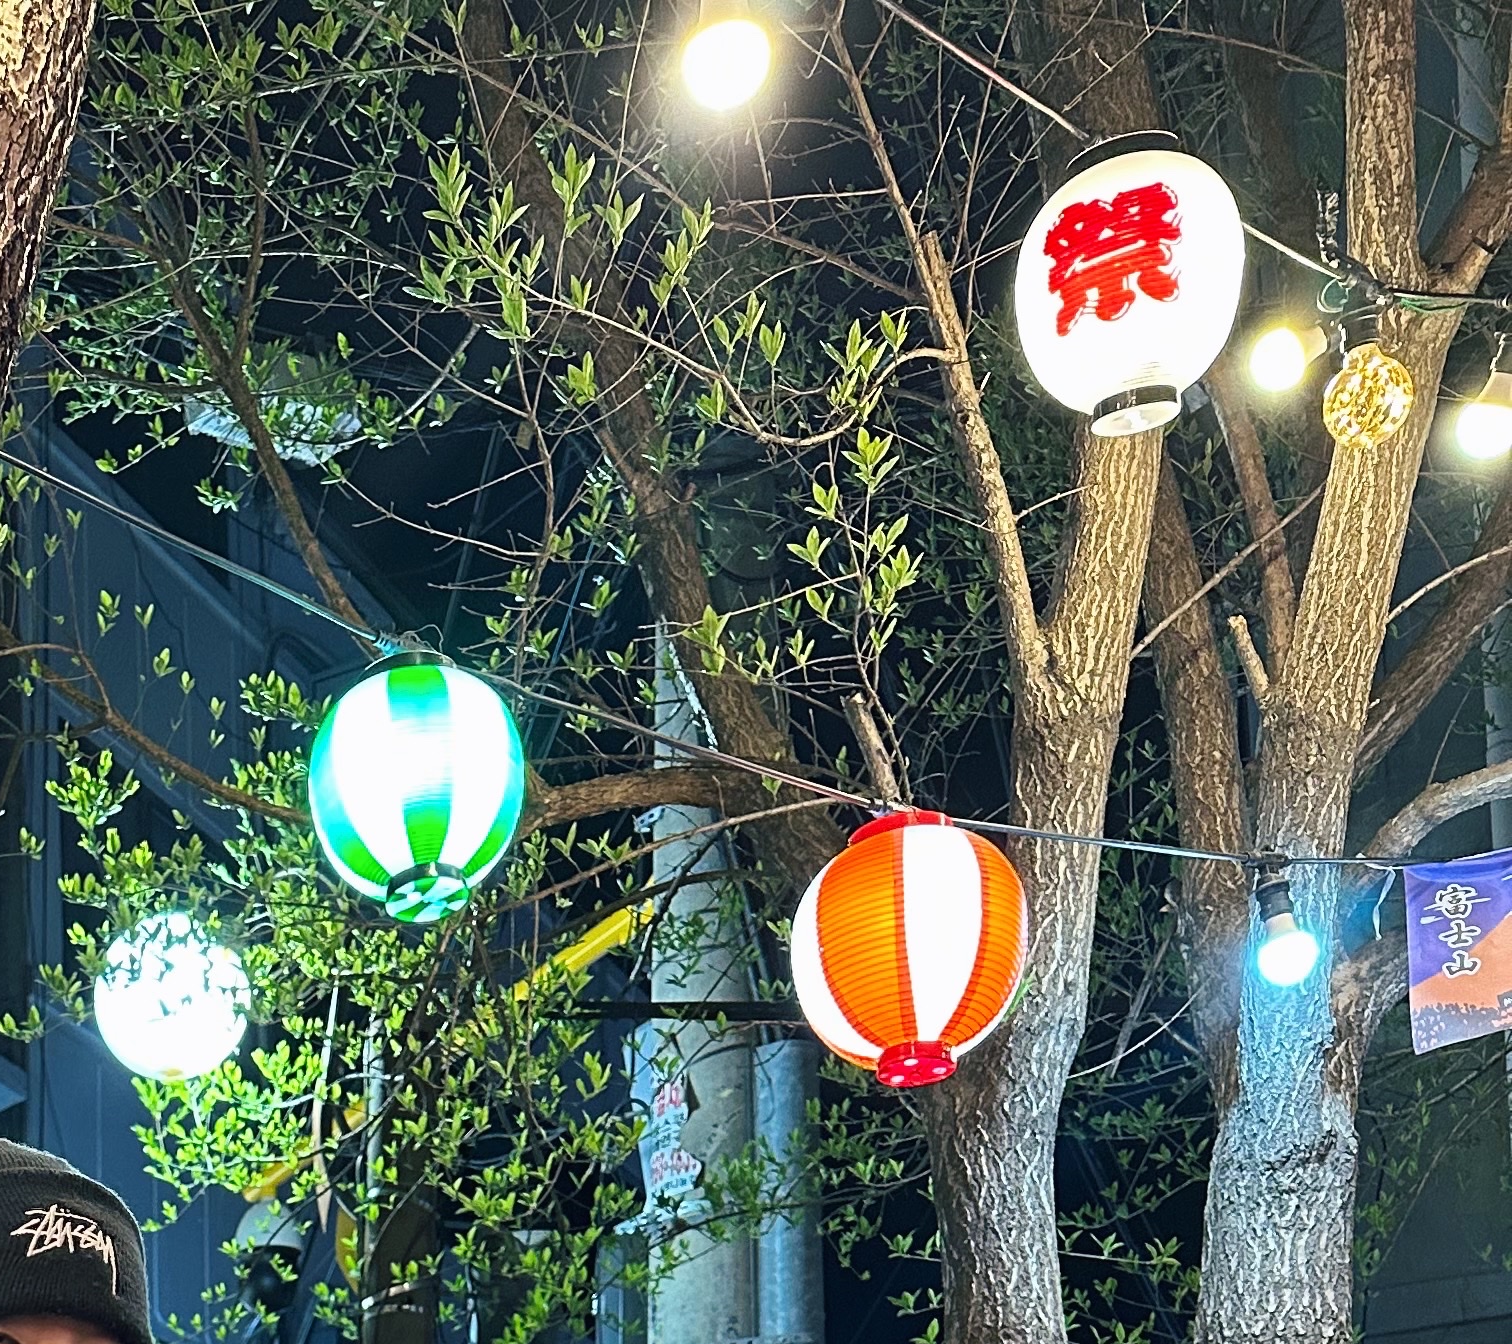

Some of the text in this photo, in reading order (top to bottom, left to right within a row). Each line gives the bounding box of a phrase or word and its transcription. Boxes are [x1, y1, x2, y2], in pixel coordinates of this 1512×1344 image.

[1045, 182, 1182, 336] 祭
[1437, 884, 1482, 978] 富士山
